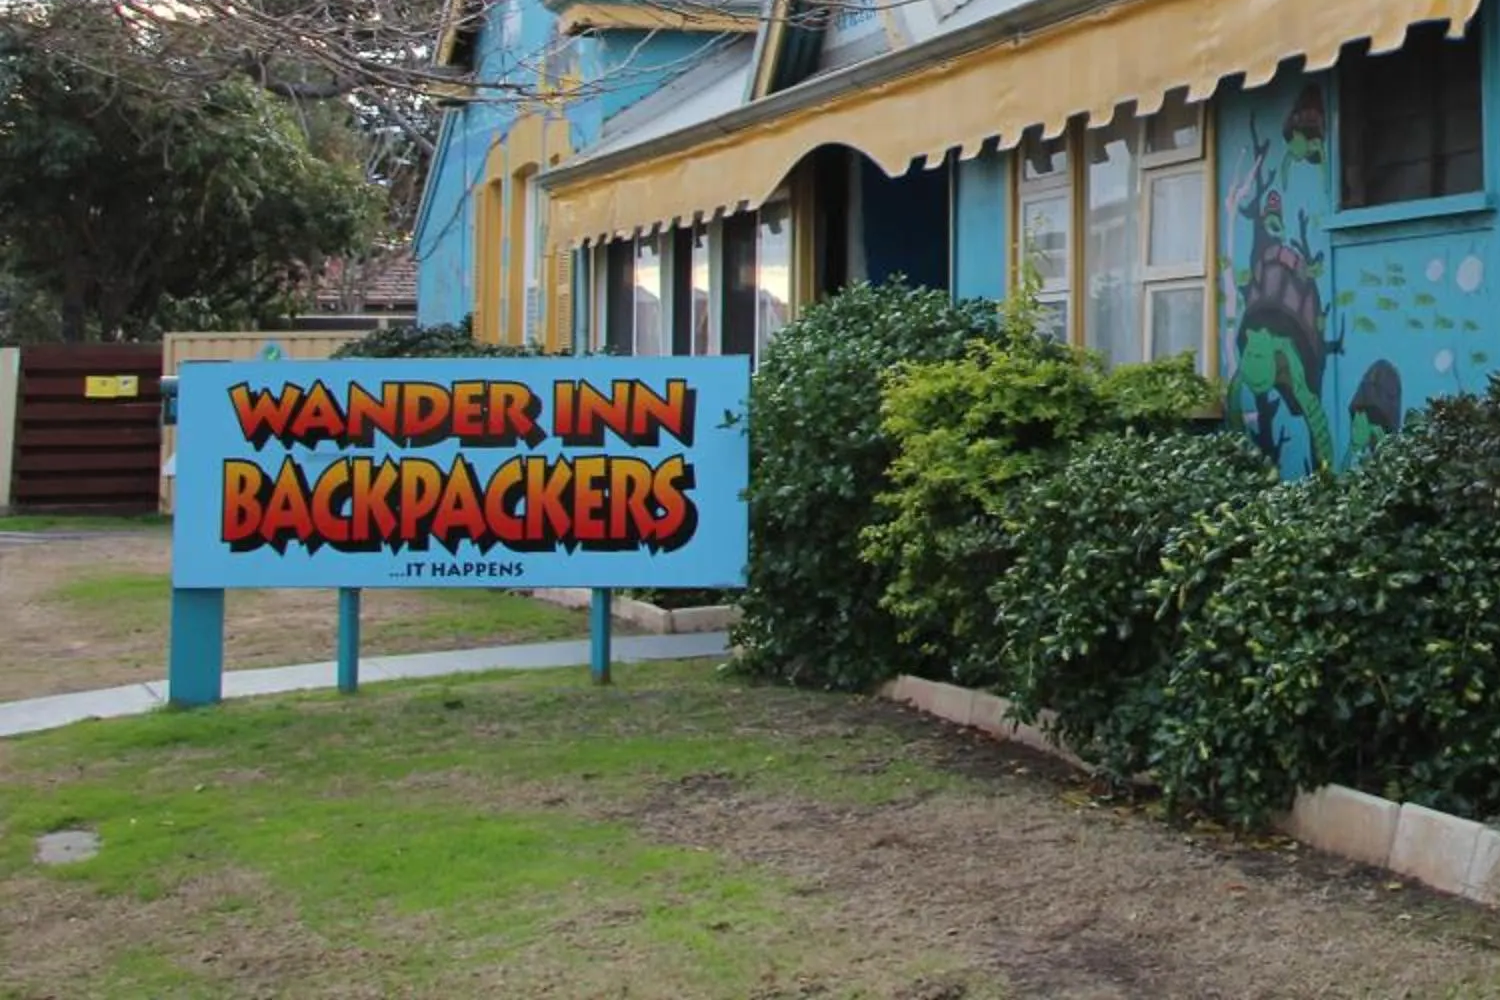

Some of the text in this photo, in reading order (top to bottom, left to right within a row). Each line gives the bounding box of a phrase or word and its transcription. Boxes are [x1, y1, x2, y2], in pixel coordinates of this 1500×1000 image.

[228, 378, 696, 450] WANDER INN
[221, 453, 699, 556] BACKPACKERS
[431, 562, 525, 577] HAPPENS
